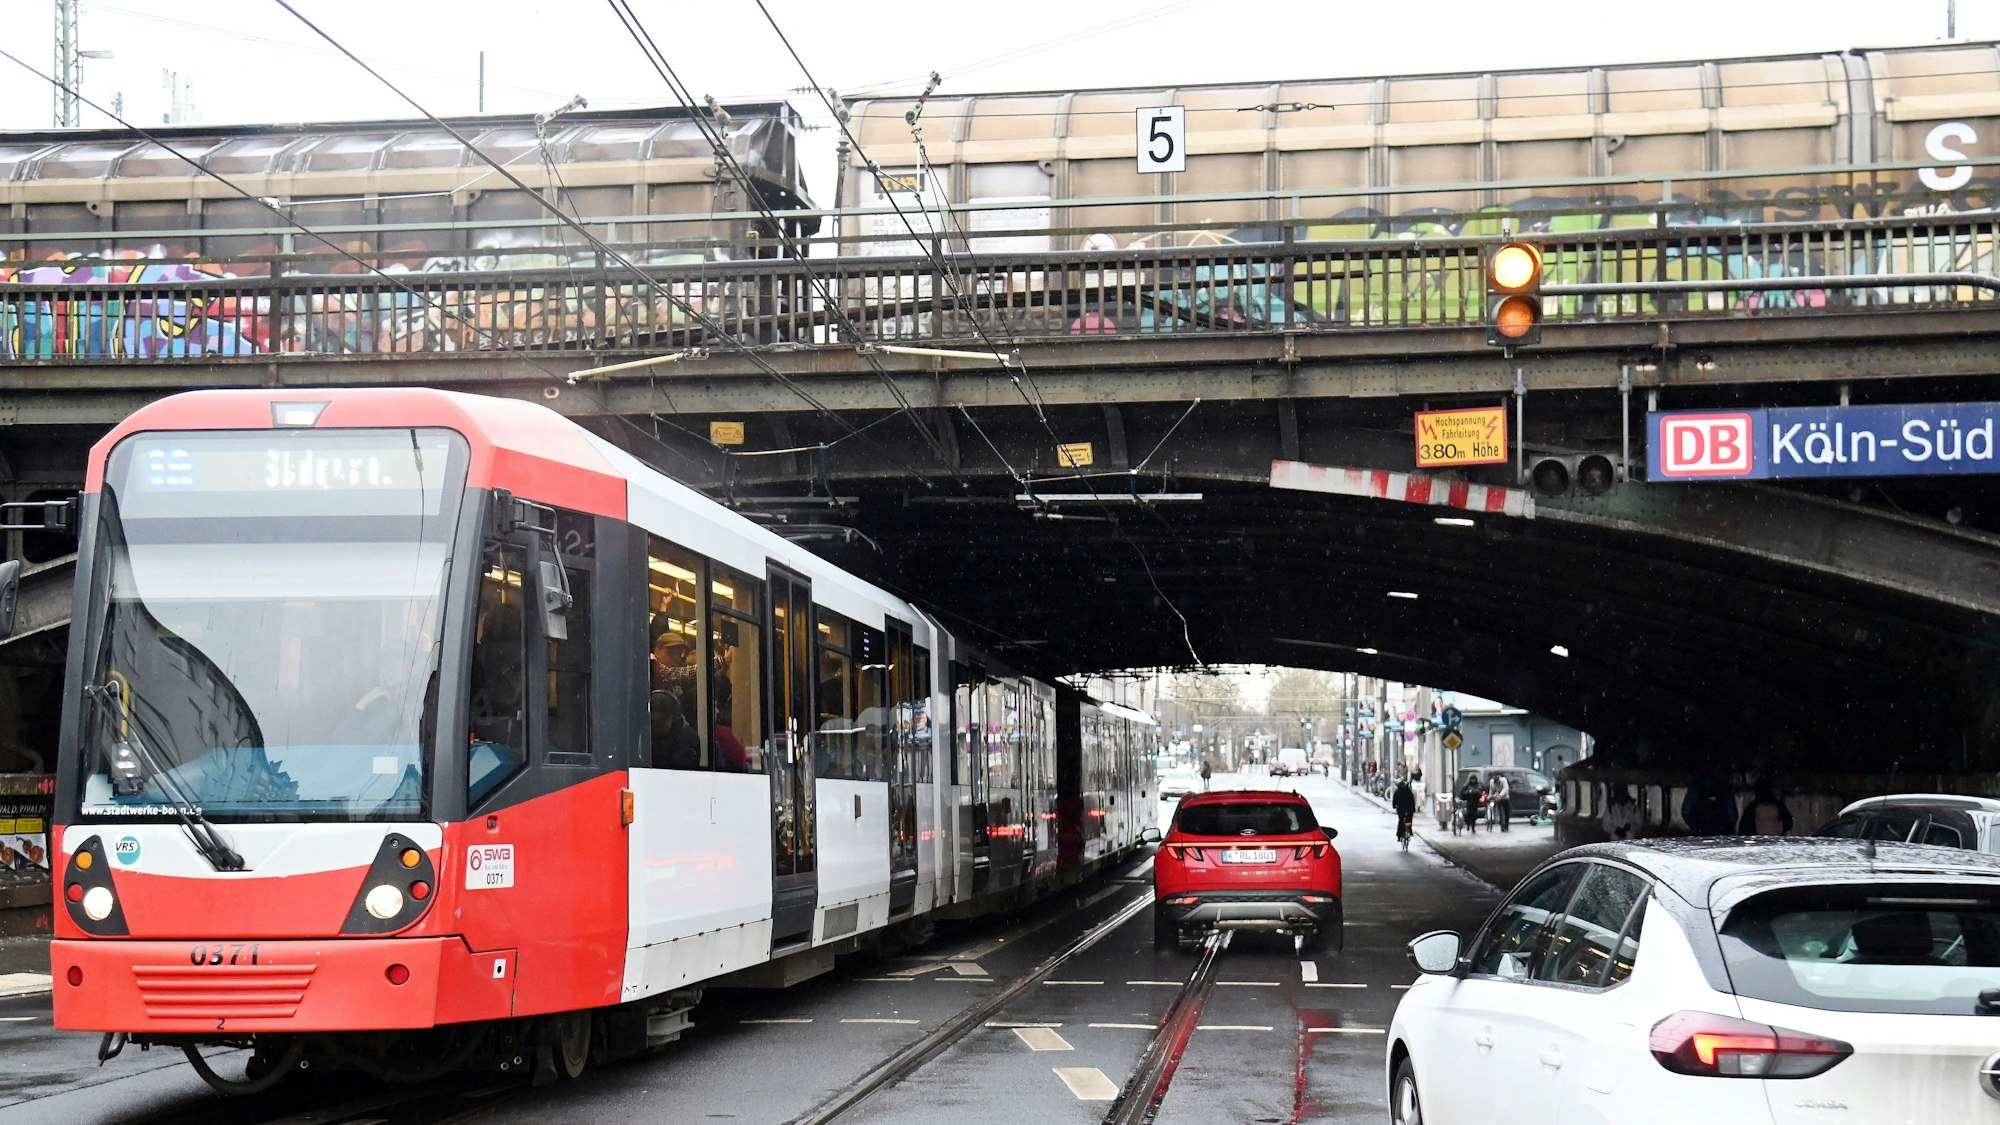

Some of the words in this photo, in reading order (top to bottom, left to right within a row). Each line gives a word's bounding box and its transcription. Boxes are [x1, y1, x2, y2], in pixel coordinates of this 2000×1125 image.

[1148, 115, 1174, 163] 5
[1918, 122, 1978, 191] S
[1435, 416, 1486, 427] Hochspannung
[1442, 428, 1480, 440] Fahrleitung
[1771, 417, 1994, 465] Köln-Süd
[1473, 441, 1499, 458] Höhe
[1672, 425, 1741, 465] DB
[115, 841, 135, 852] VRS
[484, 848, 511, 861] SWB
[486, 873, 504, 885] 0371
[190, 943, 260, 966] 0371
[216, 1017, 226, 1030] 2
